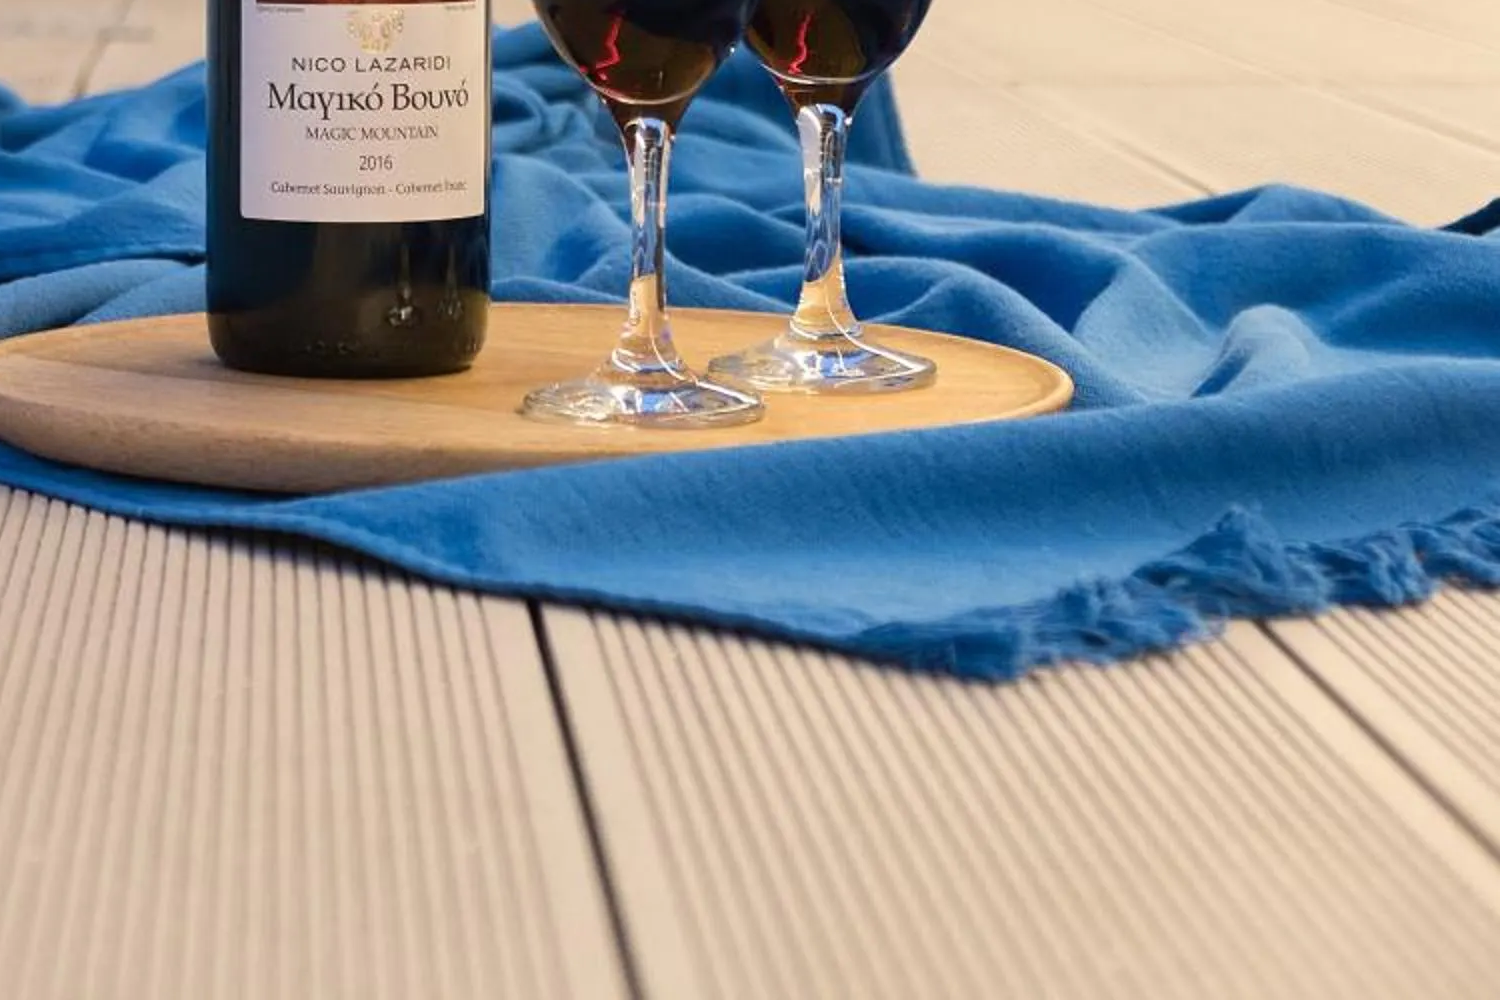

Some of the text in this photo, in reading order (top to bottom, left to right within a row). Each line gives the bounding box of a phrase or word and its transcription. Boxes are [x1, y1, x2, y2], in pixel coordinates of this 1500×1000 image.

[291, 55, 451, 73] NICO LAZARIDI
[268, 79, 469, 120] Μαγικό Βουνό
[306, 125, 438, 141] MAGIC MOUNTAIN
[359, 155, 393, 171] 2016
